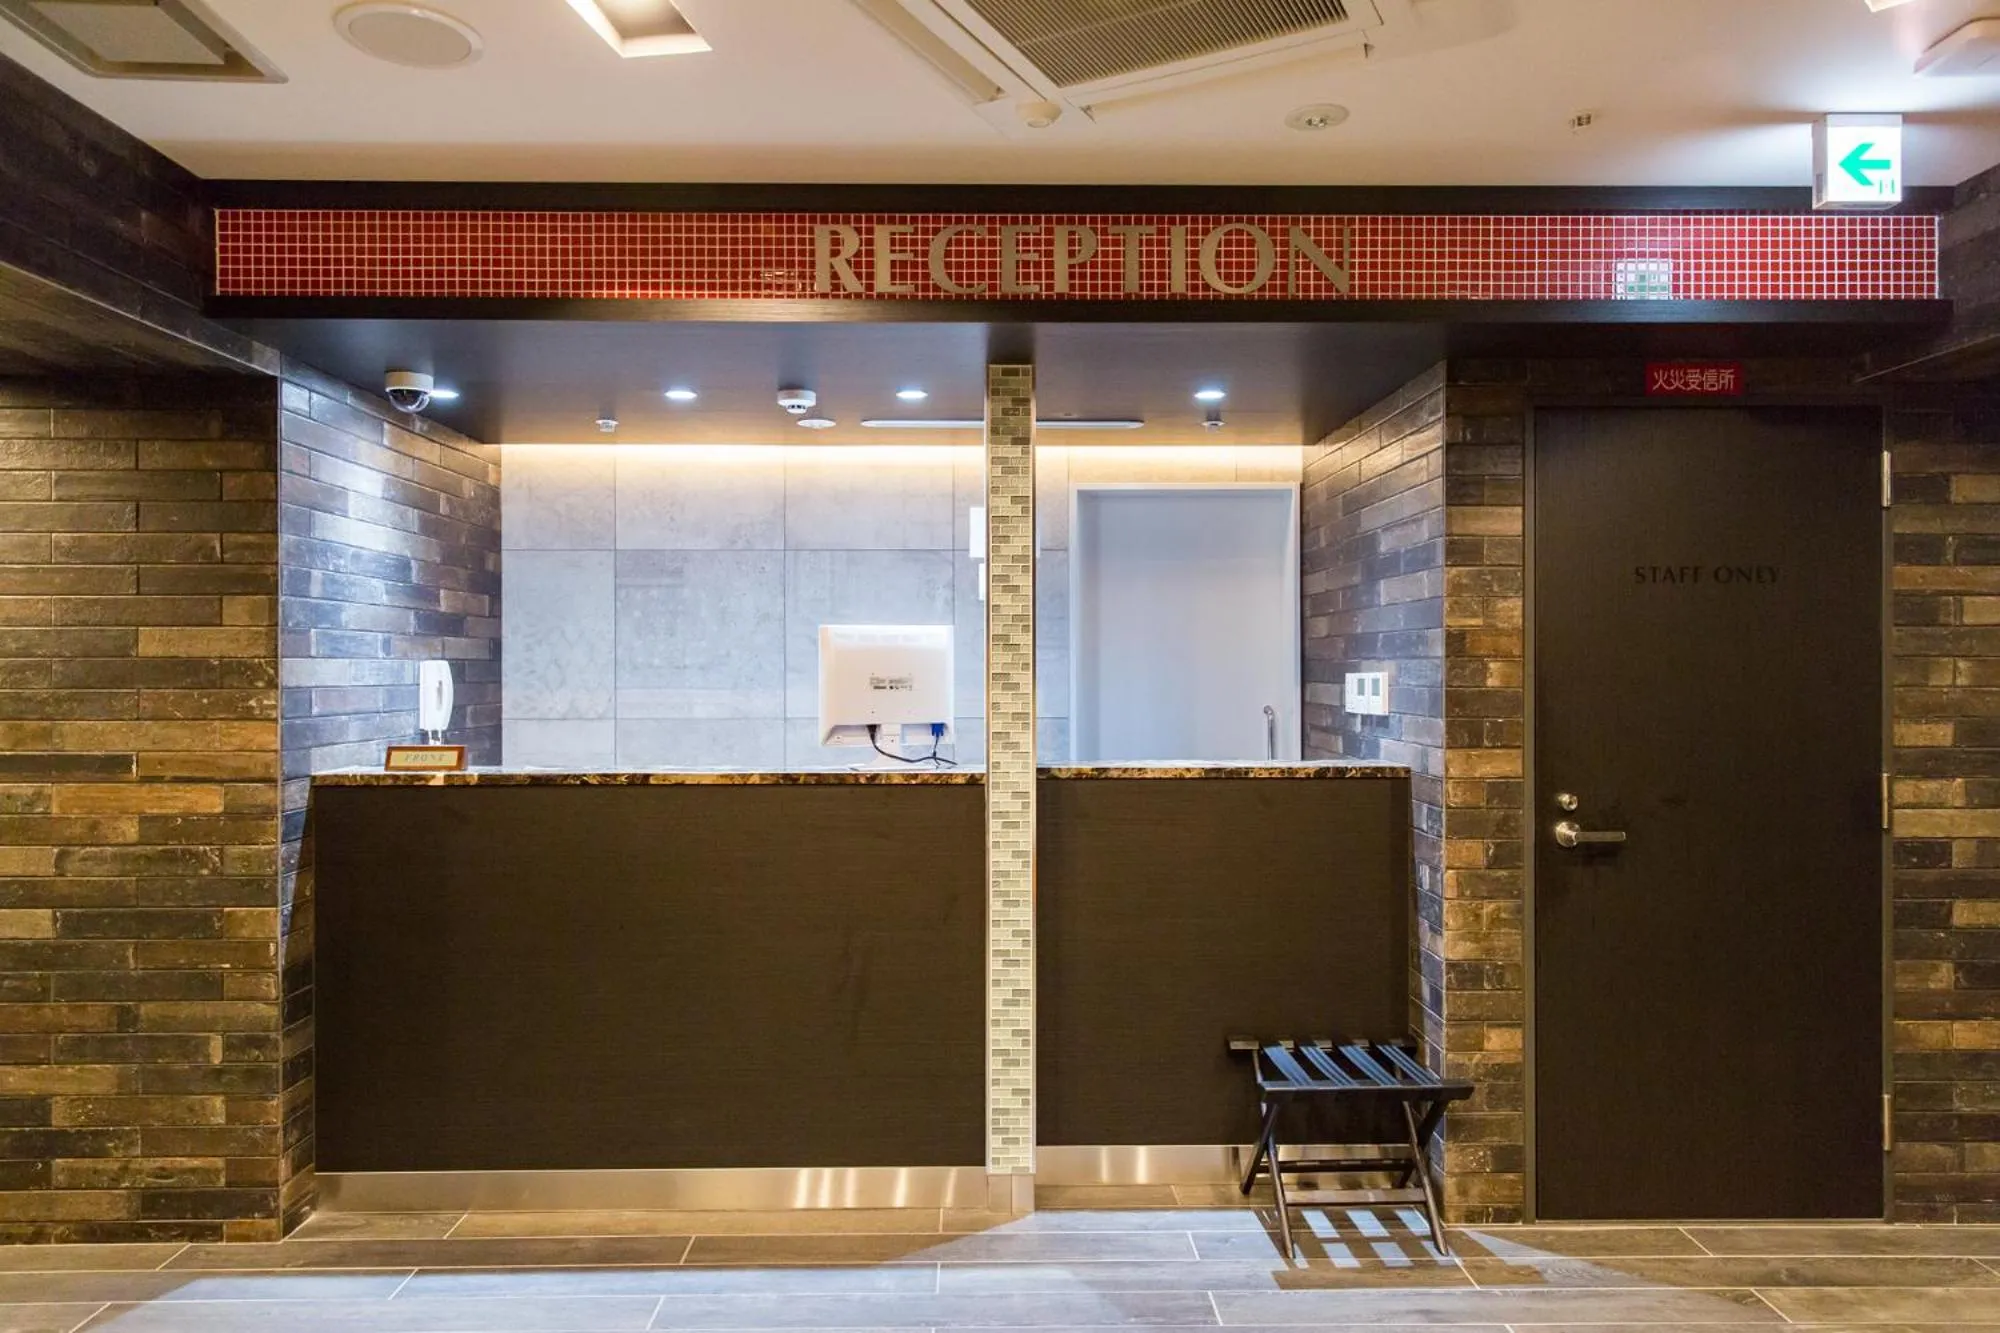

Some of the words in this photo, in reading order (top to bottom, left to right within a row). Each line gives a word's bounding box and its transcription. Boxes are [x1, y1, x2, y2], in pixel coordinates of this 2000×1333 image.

[813, 222, 1352, 295] RECEPTION
[1634, 565, 1703, 584] STAFF
[1713, 565, 1780, 584] ONLY
